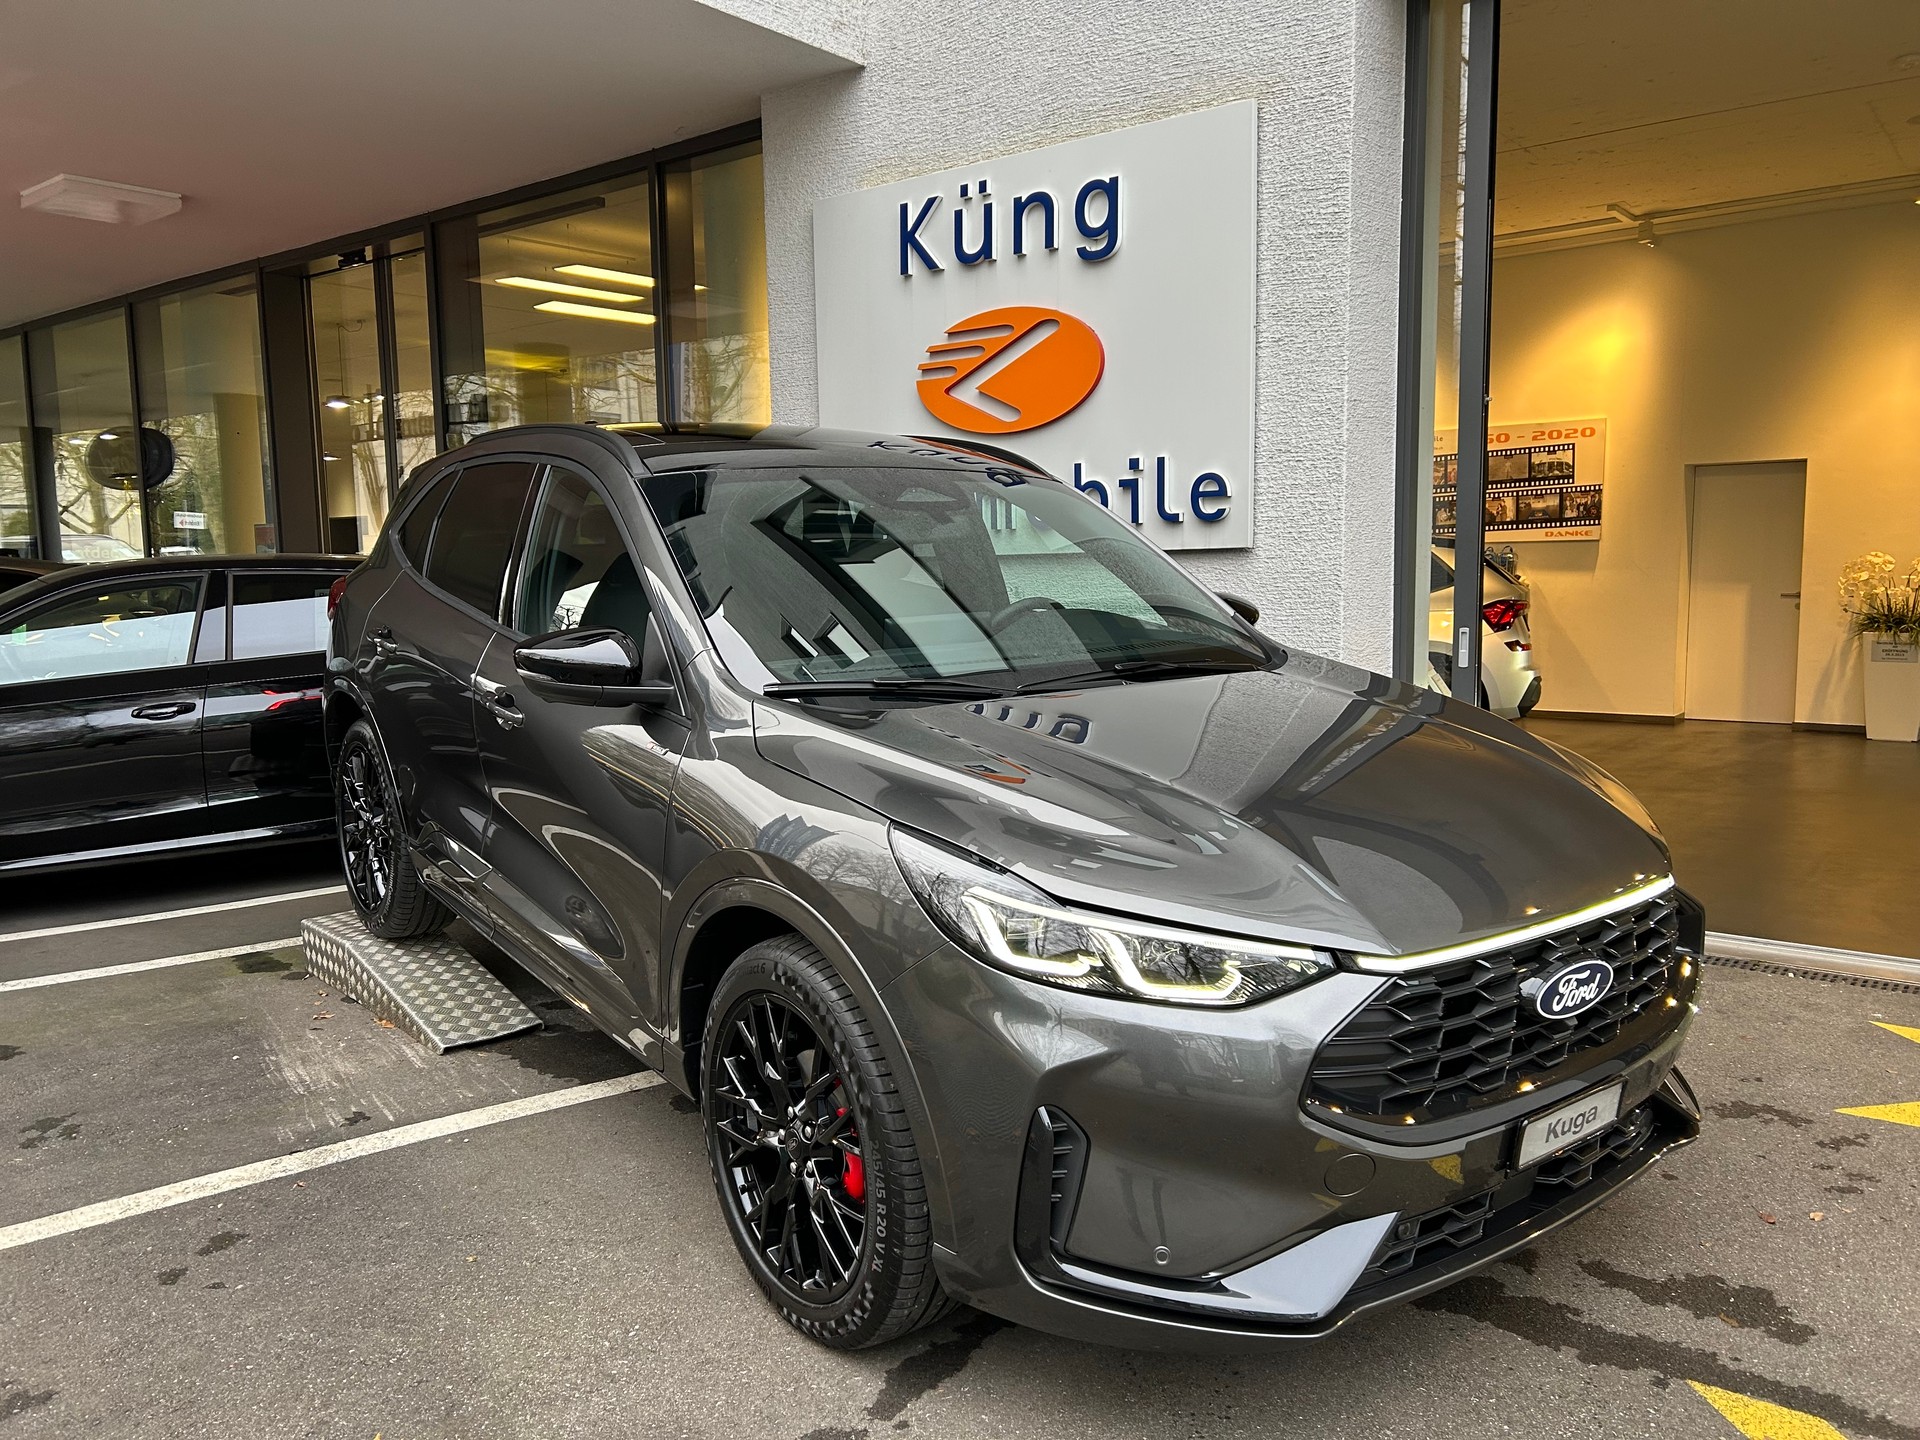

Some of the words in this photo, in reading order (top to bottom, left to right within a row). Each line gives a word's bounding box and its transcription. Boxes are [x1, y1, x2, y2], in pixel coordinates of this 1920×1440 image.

[899, 175, 1122, 277] Küng
[1531, 427, 1596, 442] 2020
[1552, 969, 1601, 1012] Ford
[1544, 1105, 1598, 1144] Kuga
[870, 1139, 886, 1199] 245/45
[871, 1254, 883, 1273] XL
